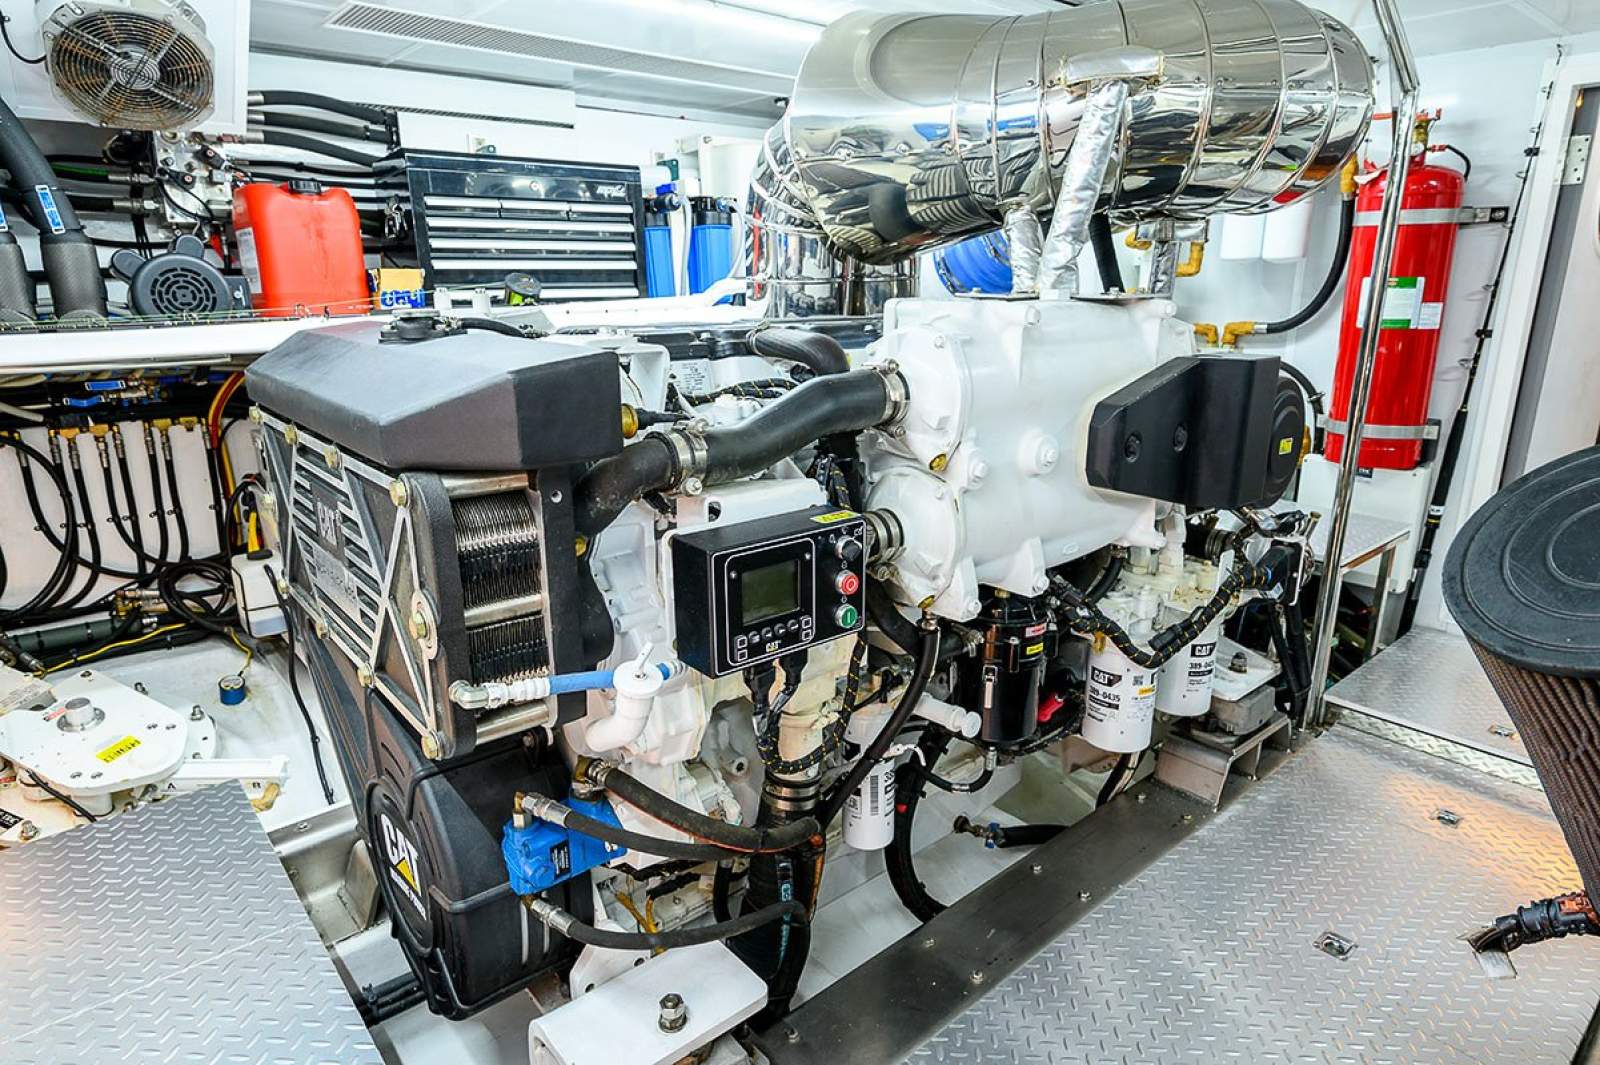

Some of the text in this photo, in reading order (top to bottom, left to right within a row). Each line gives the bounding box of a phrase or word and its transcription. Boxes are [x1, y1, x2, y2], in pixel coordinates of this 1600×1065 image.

[1194, 645, 1211, 656] CAT
[1093, 669, 1112, 684] CAT
[381, 813, 422, 897] CAT
